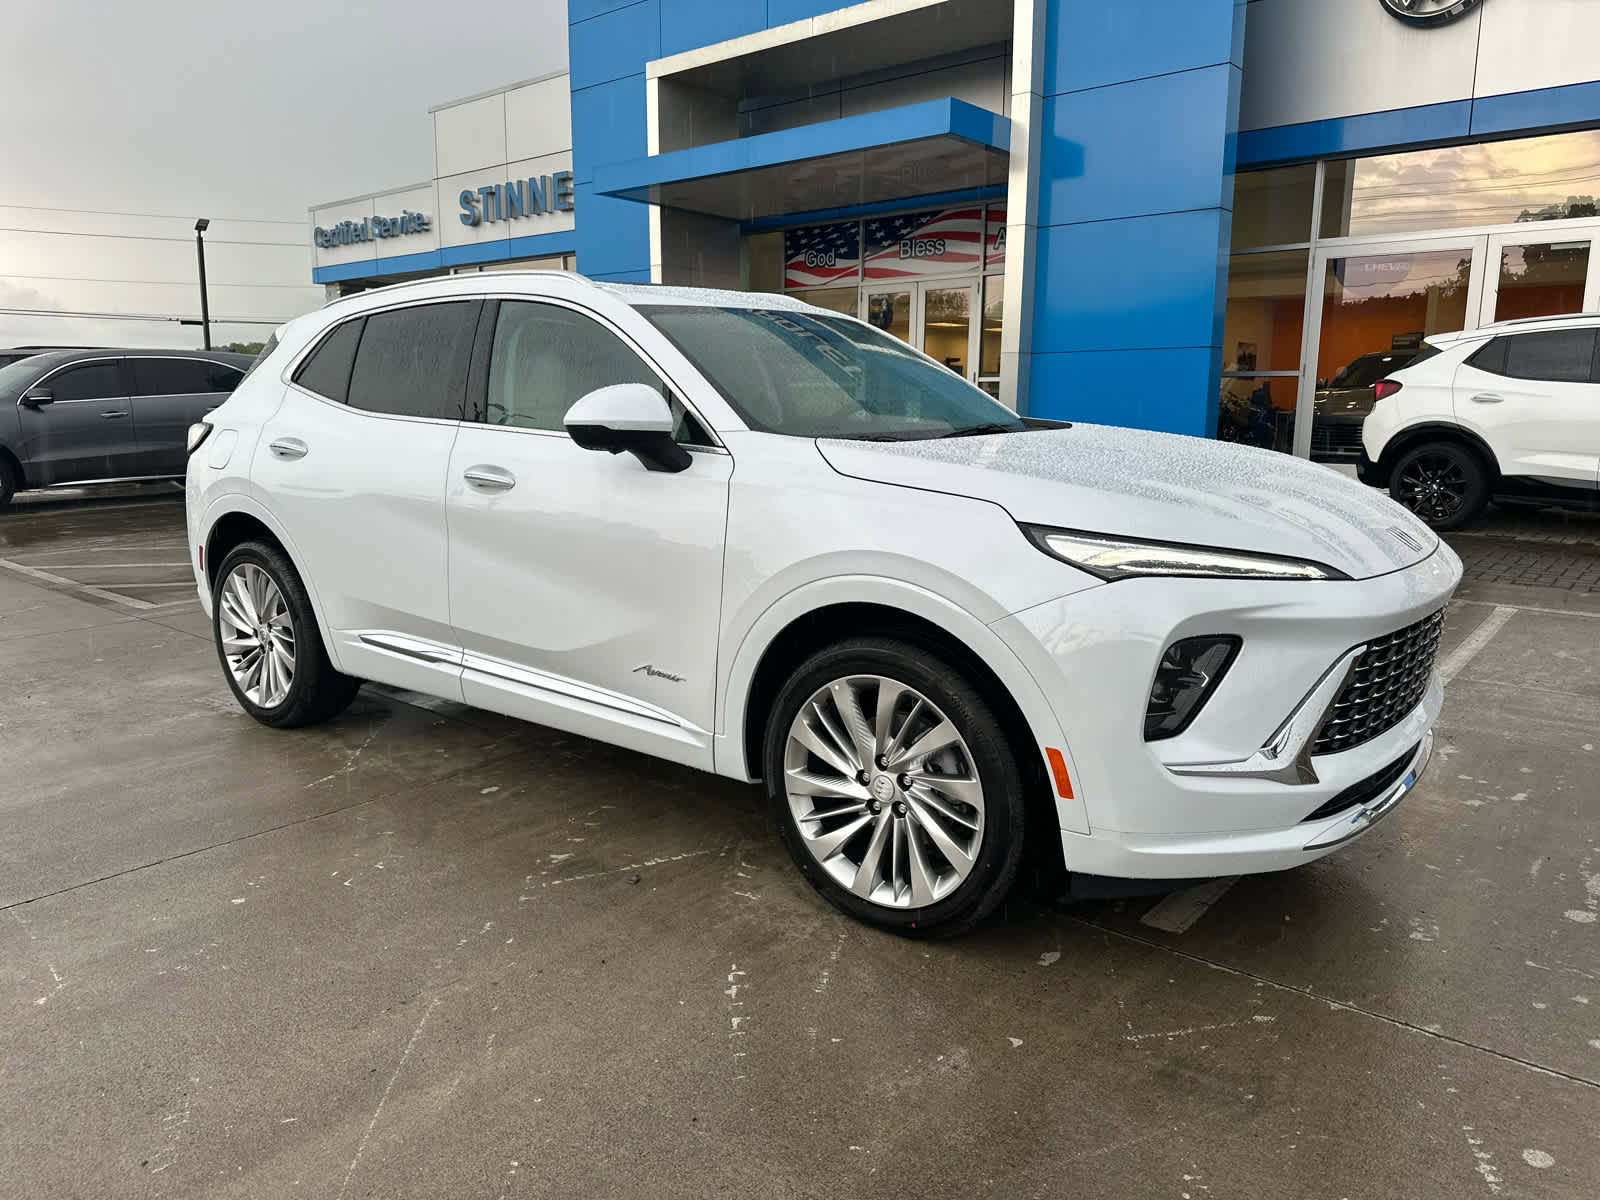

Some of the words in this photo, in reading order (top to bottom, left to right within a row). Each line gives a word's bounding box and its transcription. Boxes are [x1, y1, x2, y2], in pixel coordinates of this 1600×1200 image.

[313, 217, 372, 249] Certified
[372, 210, 428, 239] Service
[805, 248, 837, 269] God
[898, 238, 946, 259] Bless
